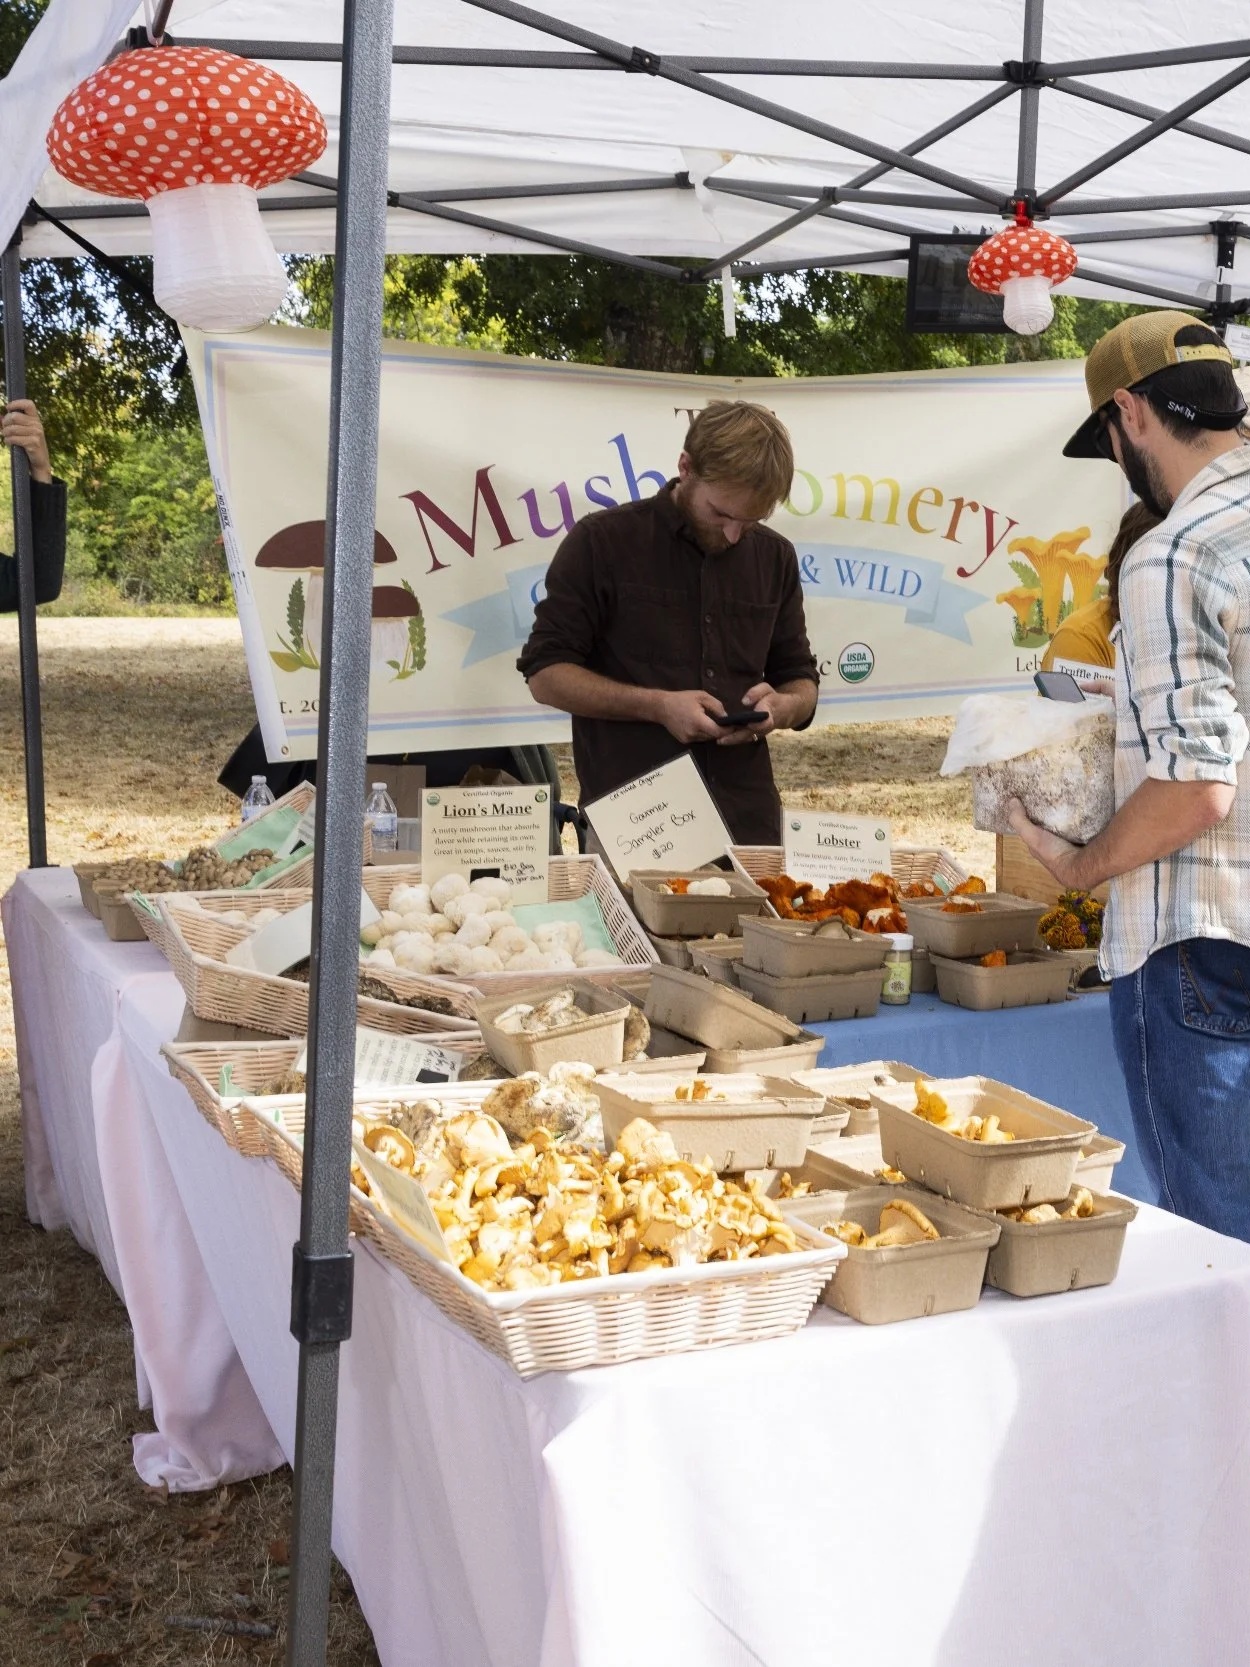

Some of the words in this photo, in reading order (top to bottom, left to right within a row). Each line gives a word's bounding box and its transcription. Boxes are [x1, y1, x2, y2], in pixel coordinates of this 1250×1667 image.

[398, 432, 1020, 579] Mushomery
[799, 554, 822, 585] &
[833, 556, 922, 598] WILD
[847, 652, 867, 662] USDA
[843, 663, 869, 673] ORGANIC
[1059, 665, 1092, 679] Truffle
[462, 790, 489, 798] Certified
[490, 790, 513, 798] Organic
[442, 803, 488, 818] Lion's
[491, 803, 533, 816] Mane
[459, 825, 497, 833] mushroom
[514, 823, 540, 831] absorbs
[616, 821, 666, 856] Sampler
[670, 809, 697, 827] Box
[456, 836, 476, 844] while
[477, 835, 508, 844] retaining
[816, 832, 862, 849] Lobster
[433, 848, 453, 857] Great
[652, 841, 674, 860] $20
[460, 857, 482, 865] baked
